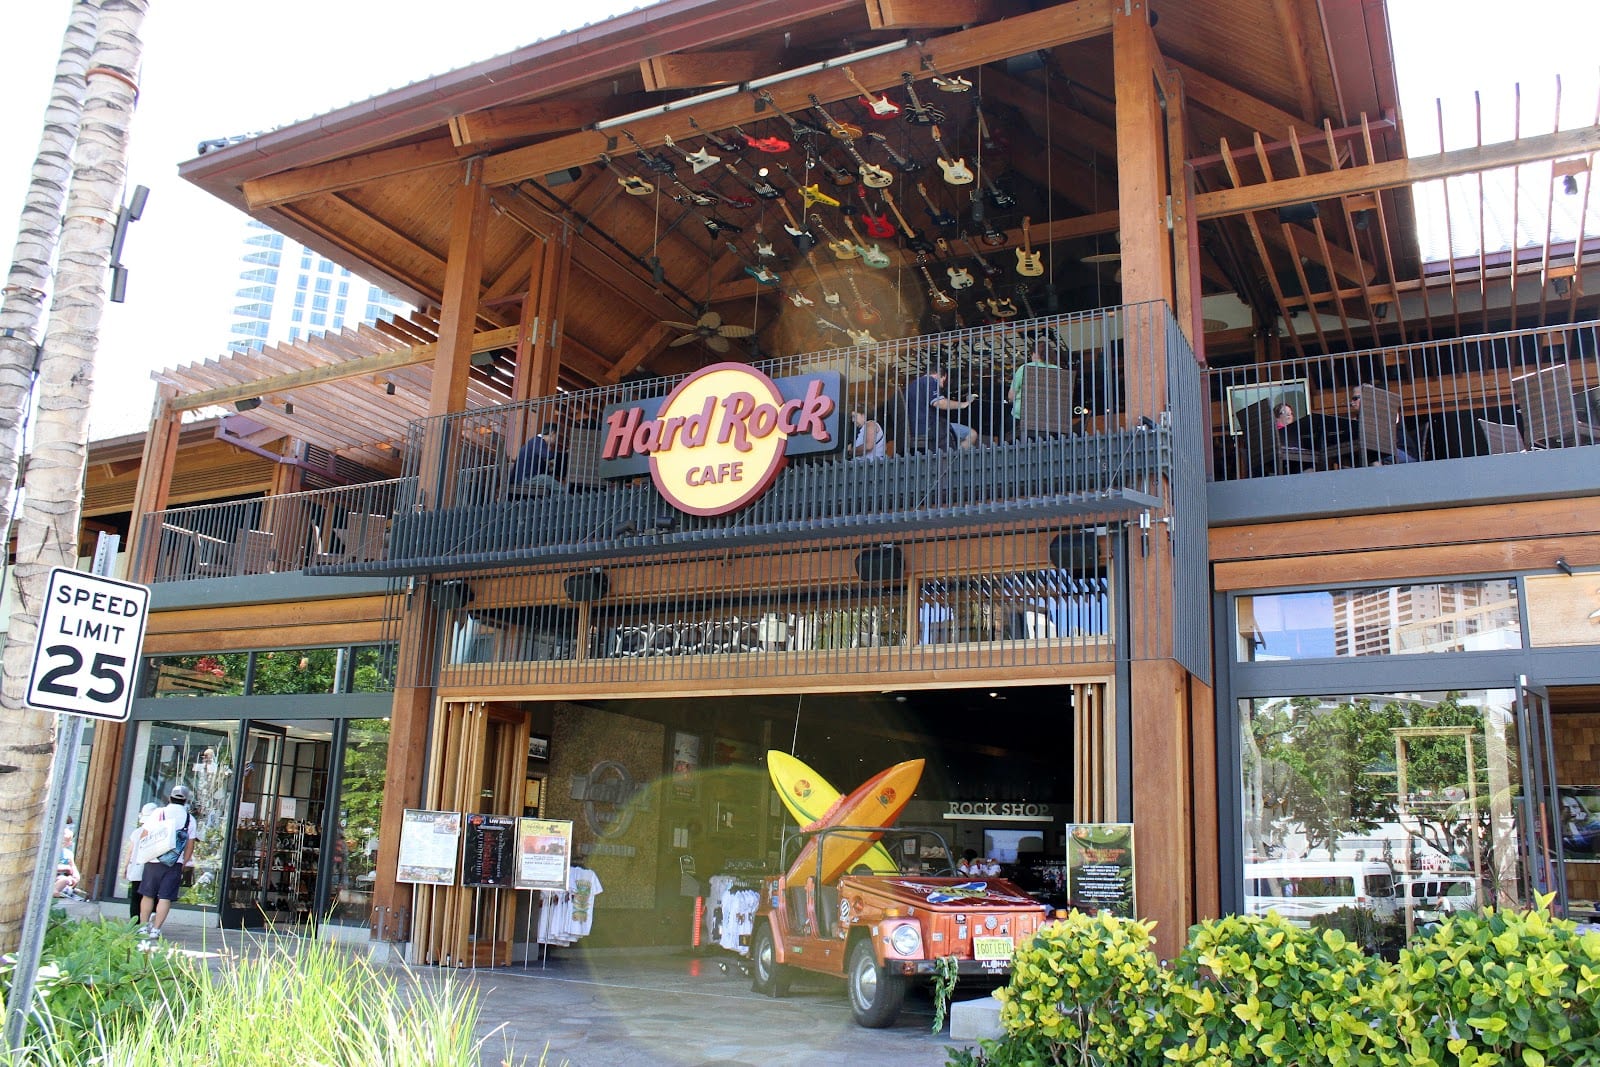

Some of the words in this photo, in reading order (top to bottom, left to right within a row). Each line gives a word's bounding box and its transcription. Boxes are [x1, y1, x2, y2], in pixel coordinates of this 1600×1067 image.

[602, 395, 717, 460] Hard
[717, 378, 835, 452] Rock
[686, 461, 743, 487] CAFE
[56, 585, 139, 618] SPEED
[59, 615, 126, 644] LIMIT
[37, 644, 126, 703] 25
[949, 801, 997, 815] ROCK
[1002, 803, 1049, 816] SHOP
